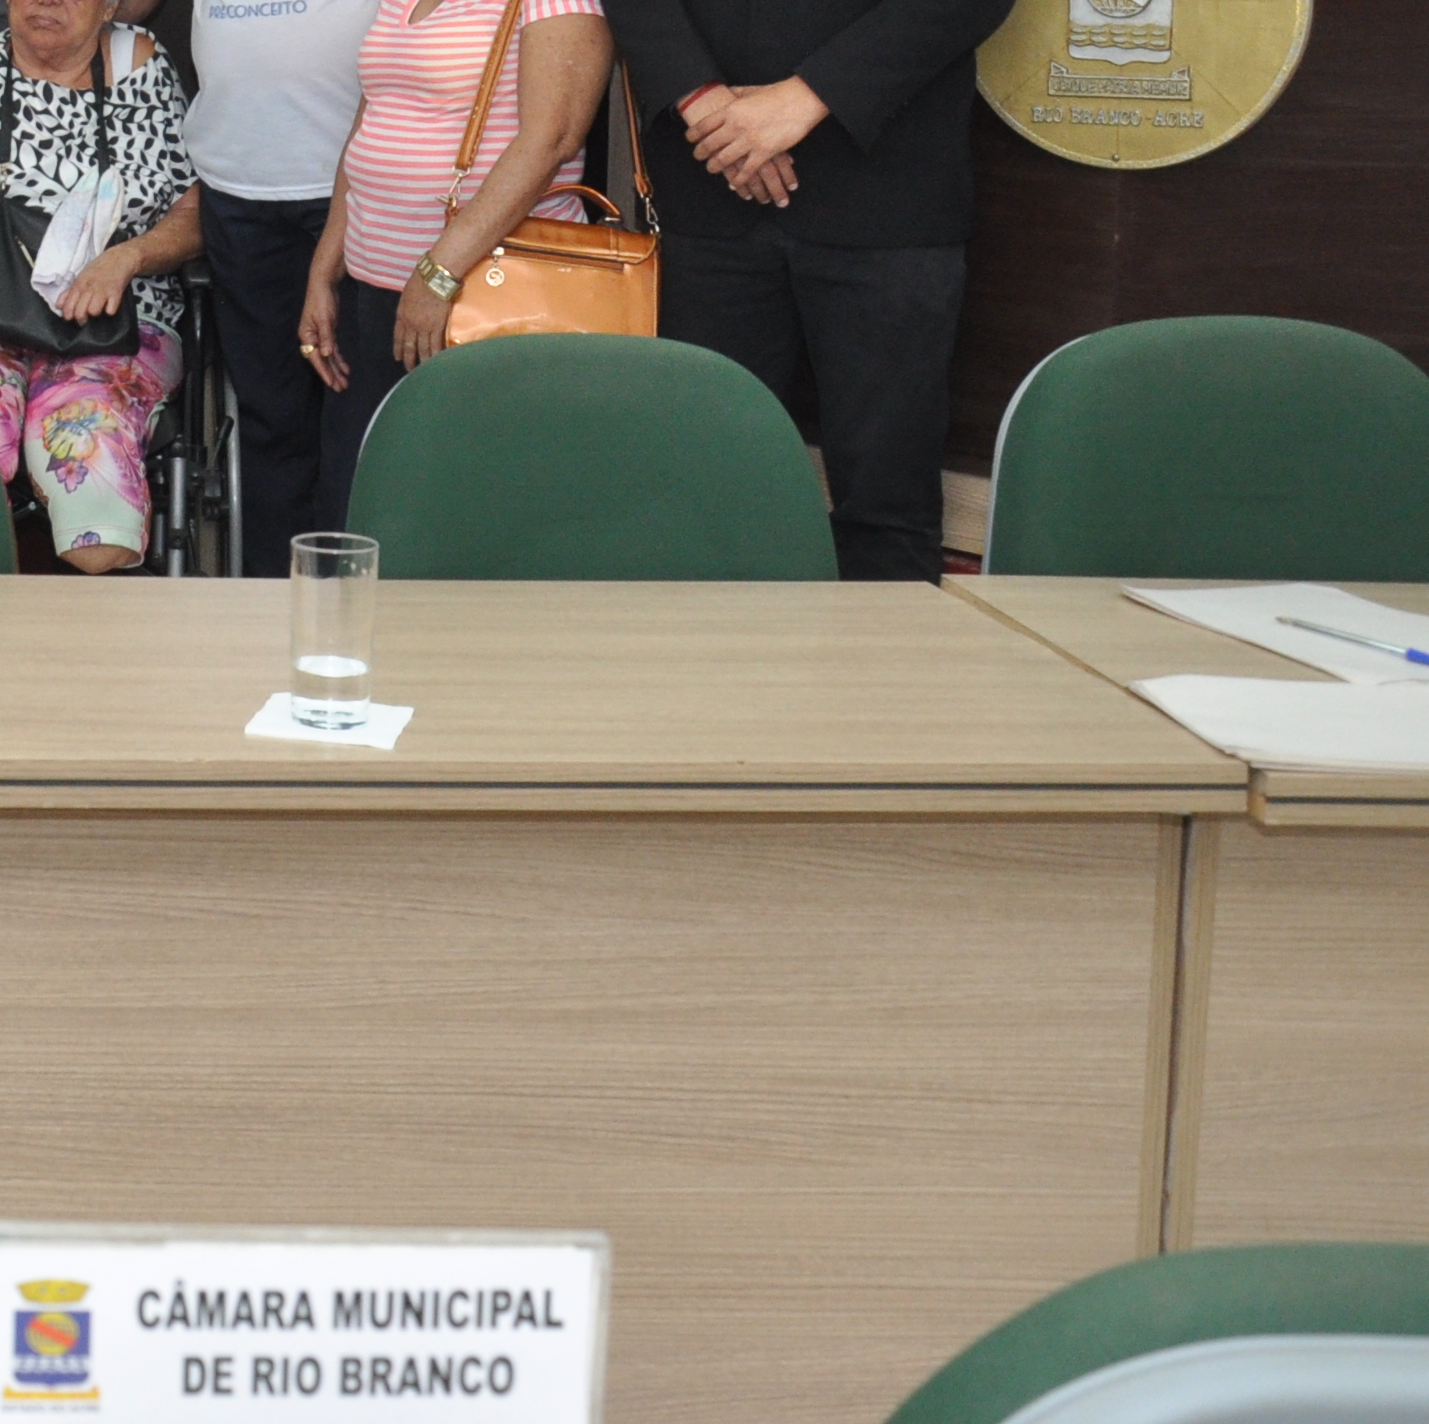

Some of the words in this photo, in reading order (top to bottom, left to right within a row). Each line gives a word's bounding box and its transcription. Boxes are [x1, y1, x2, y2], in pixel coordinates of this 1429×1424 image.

[1032, 105, 1064, 124] RIO
[1070, 106, 1142, 127] BRANCO
[1152, 109, 1205, 129] ACRE
[136, 1279, 316, 1331] CÂMARA
[331, 1289, 565, 1331] MUNICIPAL
[182, 1356, 233, 1396] DE
[251, 1356, 322, 1396] RIO
[340, 1356, 515, 1397] BRANCO
